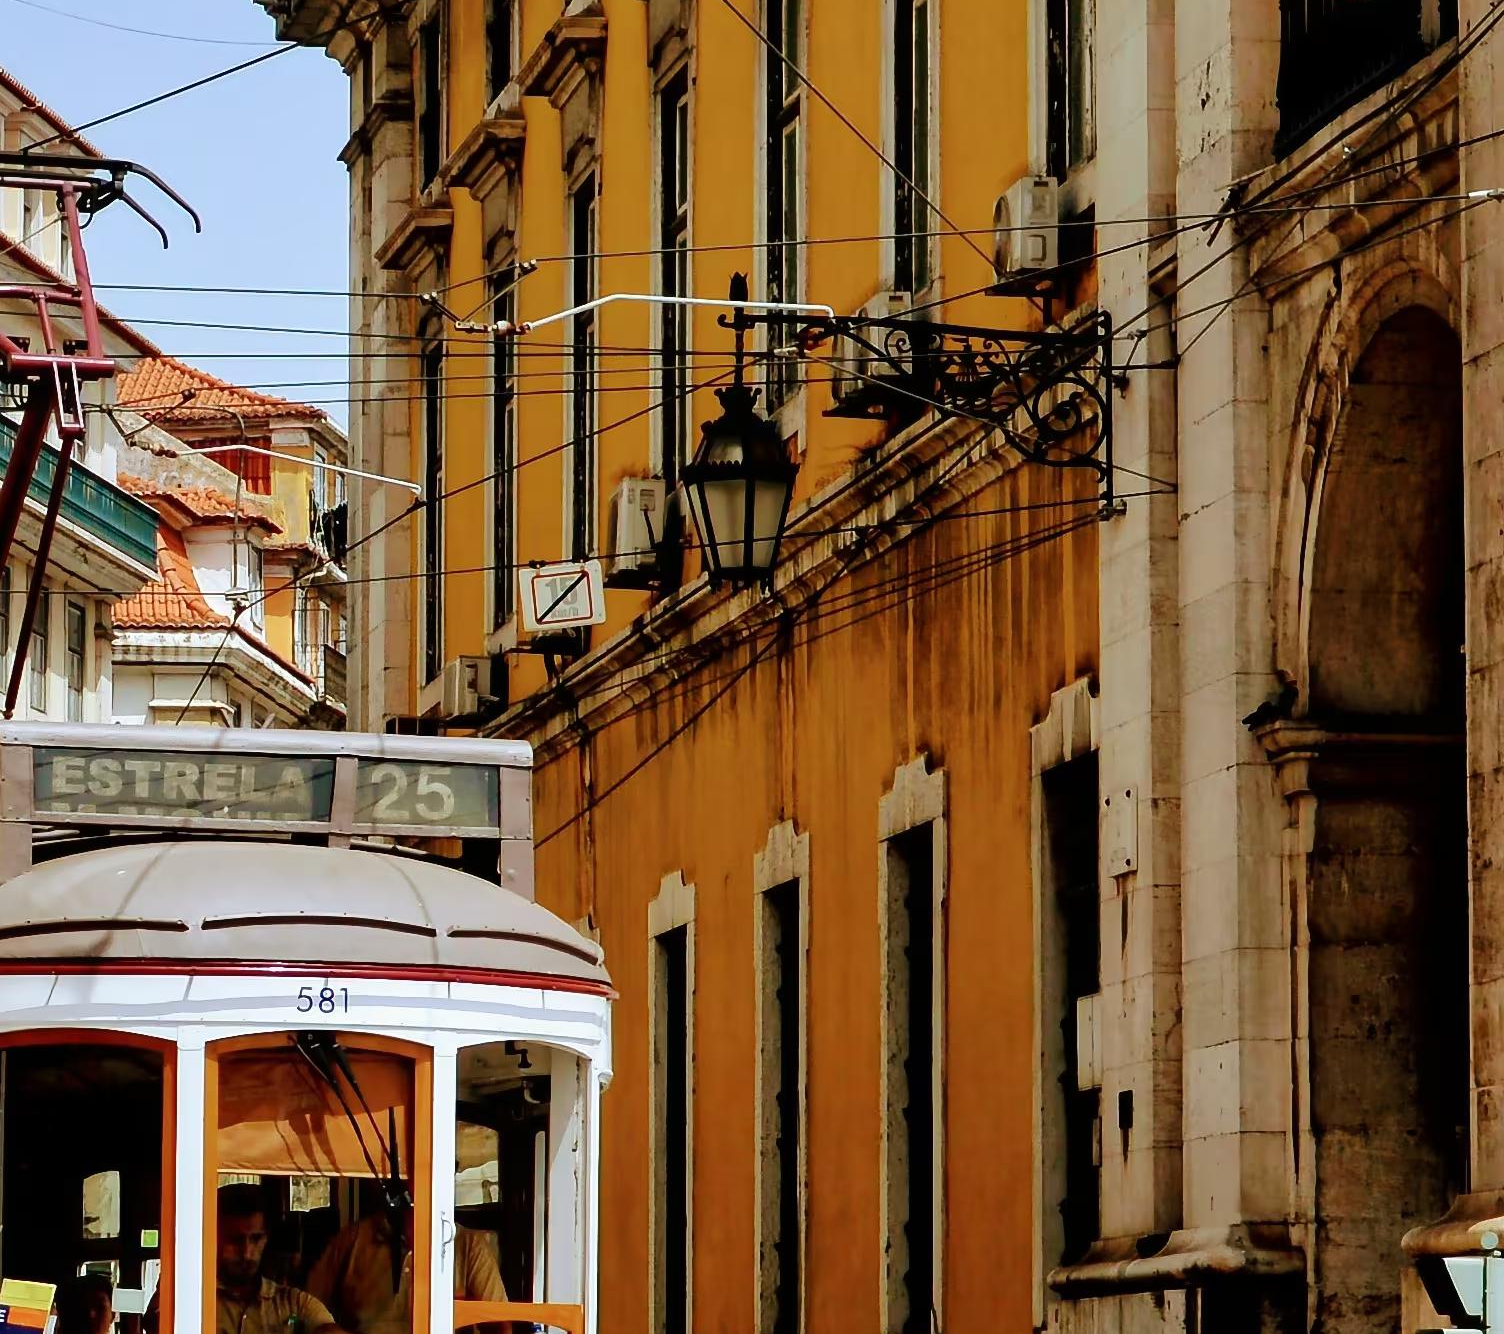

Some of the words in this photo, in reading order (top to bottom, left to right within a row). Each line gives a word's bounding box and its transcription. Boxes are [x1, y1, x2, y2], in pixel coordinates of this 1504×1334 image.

[51, 755, 313, 807] ESTRELA
[371, 762, 455, 821] 25
[296, 986, 348, 1014] 581
